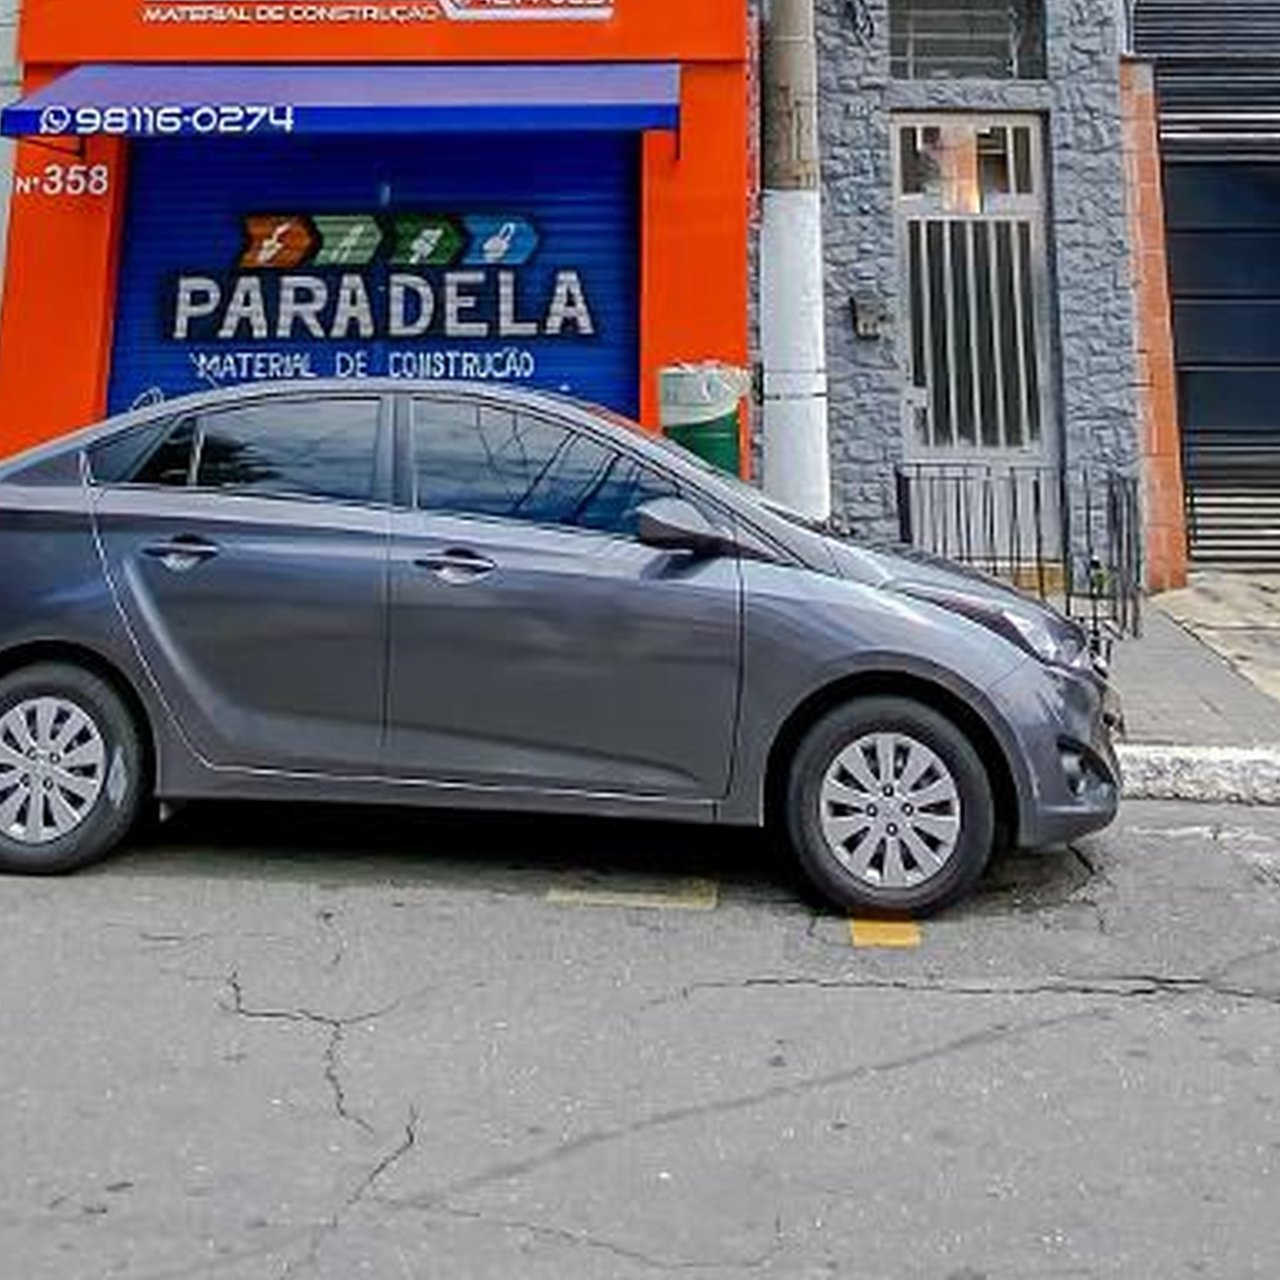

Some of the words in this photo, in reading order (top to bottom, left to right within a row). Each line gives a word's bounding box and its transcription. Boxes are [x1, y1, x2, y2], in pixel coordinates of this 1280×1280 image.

[142, 5, 251, 22] MATERIAL
[75, 106, 294, 133] 98116-0274
[42, 164, 109, 194] 358
[172, 270, 595, 339] PARADELA
[190, 352, 316, 379] MATERIAL
[335, 351, 368, 377] DE
